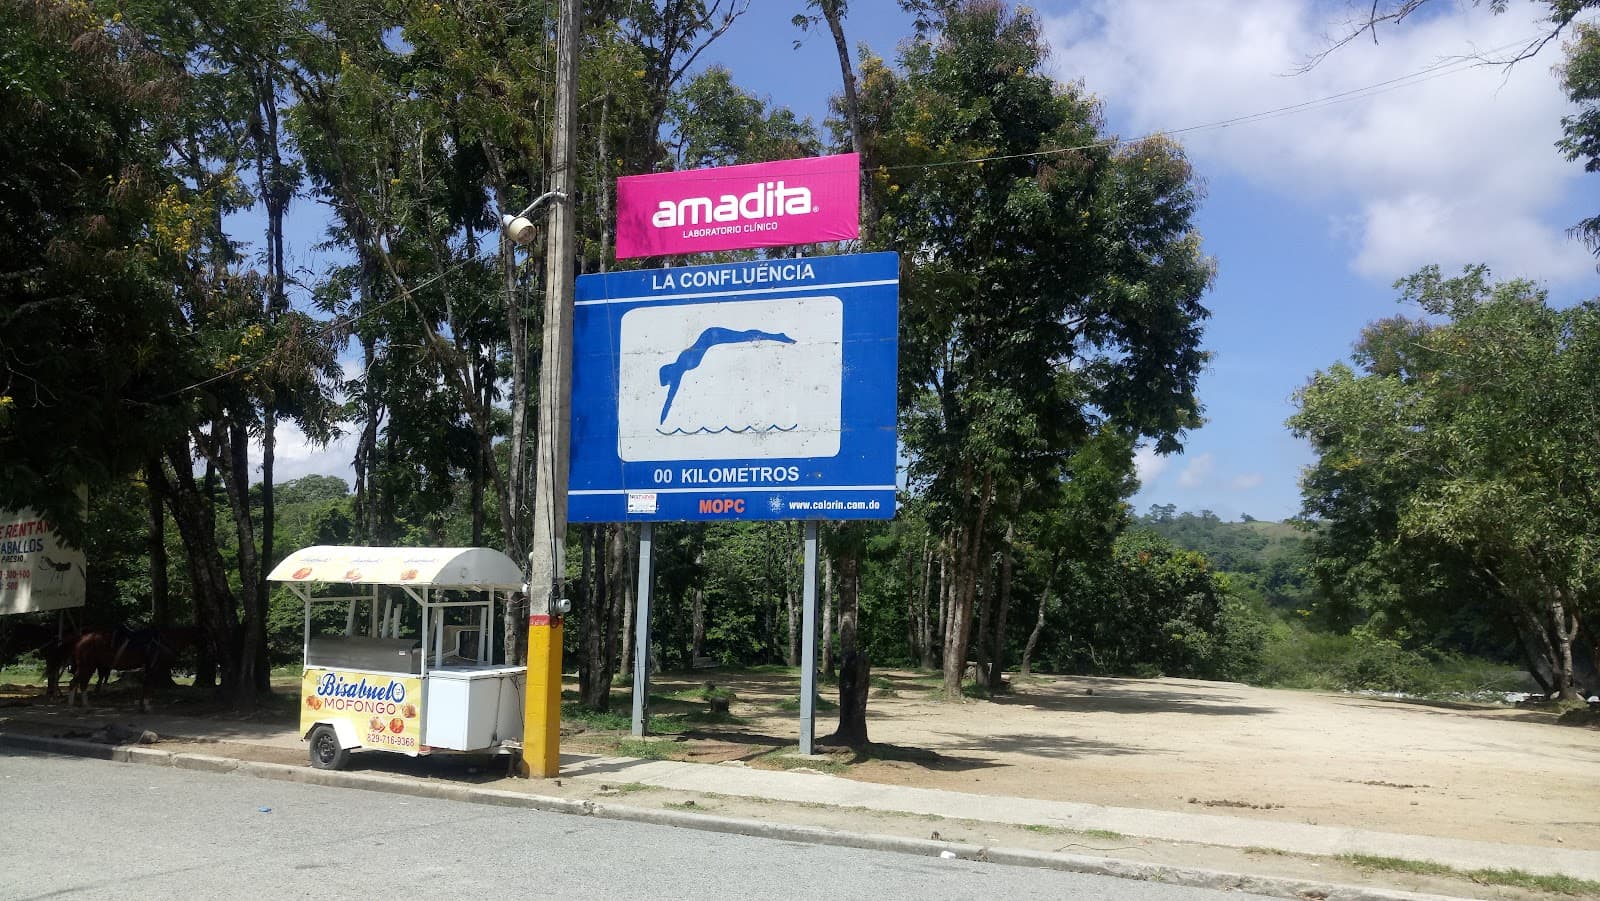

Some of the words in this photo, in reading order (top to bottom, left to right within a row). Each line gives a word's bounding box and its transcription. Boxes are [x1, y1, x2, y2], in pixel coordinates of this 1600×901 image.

[652, 180, 811, 228] amadita
[682, 225, 741, 238] LABORATORIO
[743, 221, 778, 234] CLÍNICO
[652, 273, 676, 290] LA
[653, 469, 673, 484] 00
[681, 466, 800, 484] KILOMETROS
[699, 498, 745, 514] MOPC
[789, 499, 880, 511] www.colorin.com.do
[0, 539, 43, 554] ABALLOS
[324, 697, 396, 715] MOFONGO
[367, 733, 415, 747] 829-716-9368
